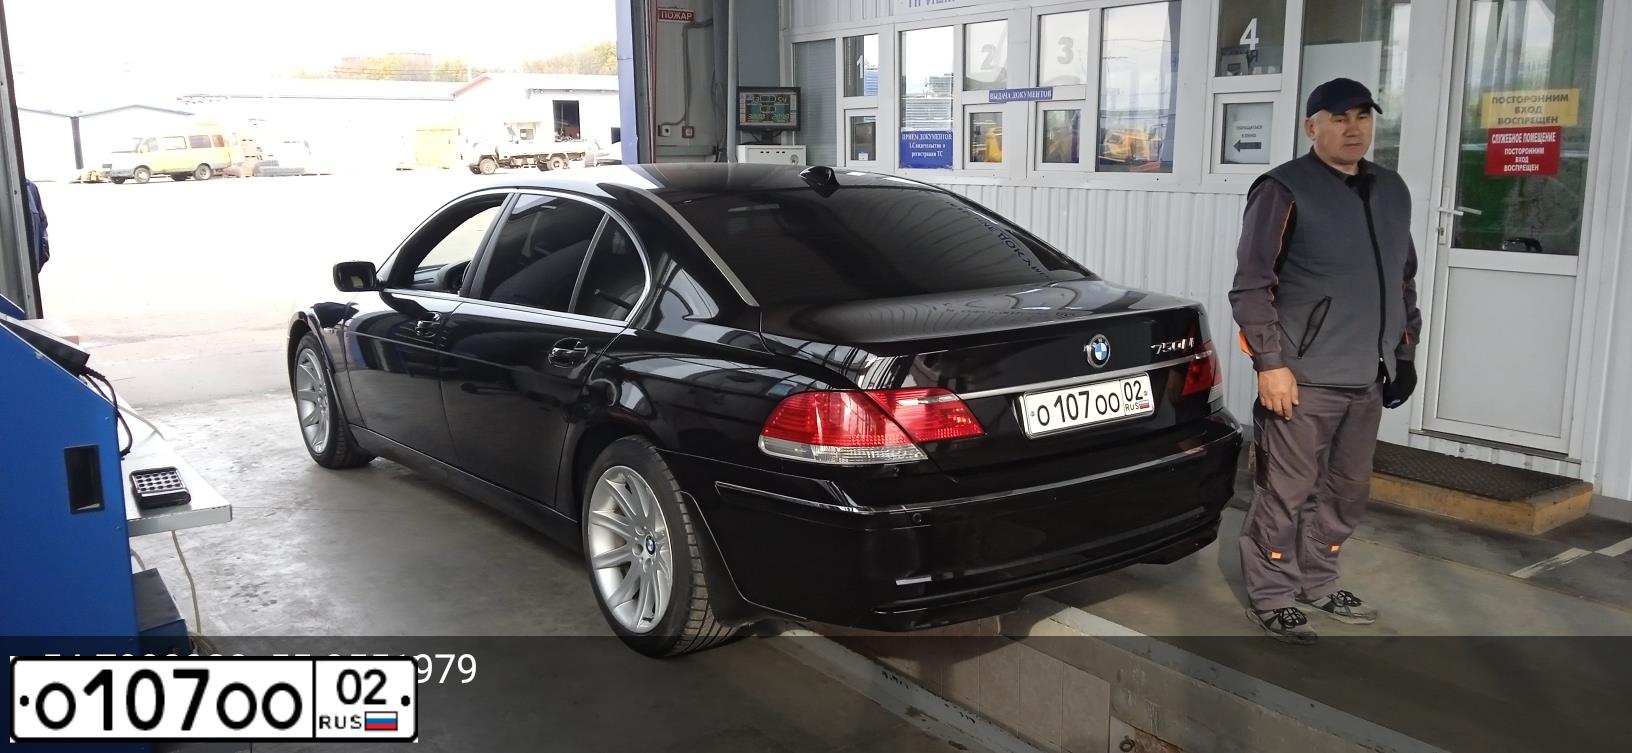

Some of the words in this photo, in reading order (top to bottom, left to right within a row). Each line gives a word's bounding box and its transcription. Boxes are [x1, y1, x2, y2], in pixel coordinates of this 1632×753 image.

[661, 10, 692, 20] ПОЖАР
[1239, 17, 1259, 50] 4
[1057, 37, 1074, 64] 3
[980, 44, 997, 70] 2
[856, 54, 864, 79] 1
[1012, 90, 1052, 98] ДОКУМЕНТОВ
[1492, 94, 1569, 104] ПОСТОРОННИМ
[1515, 106, 1542, 114] ВХОД
[1498, 116, 1558, 125] ВОСПРЕЩЕН
[1491, 133, 1522, 144] СЛУЖЕБНОЕ
[1522, 131, 1556, 144] ПОМЕЩЕНИЕ
[1504, 147, 1545, 155] ПОСТОРОННИМ
[1503, 164, 1540, 172] ВОСПРЕЩЕН
[1123, 380, 1143, 402] 02
[1124, 402, 1139, 412] RUS
